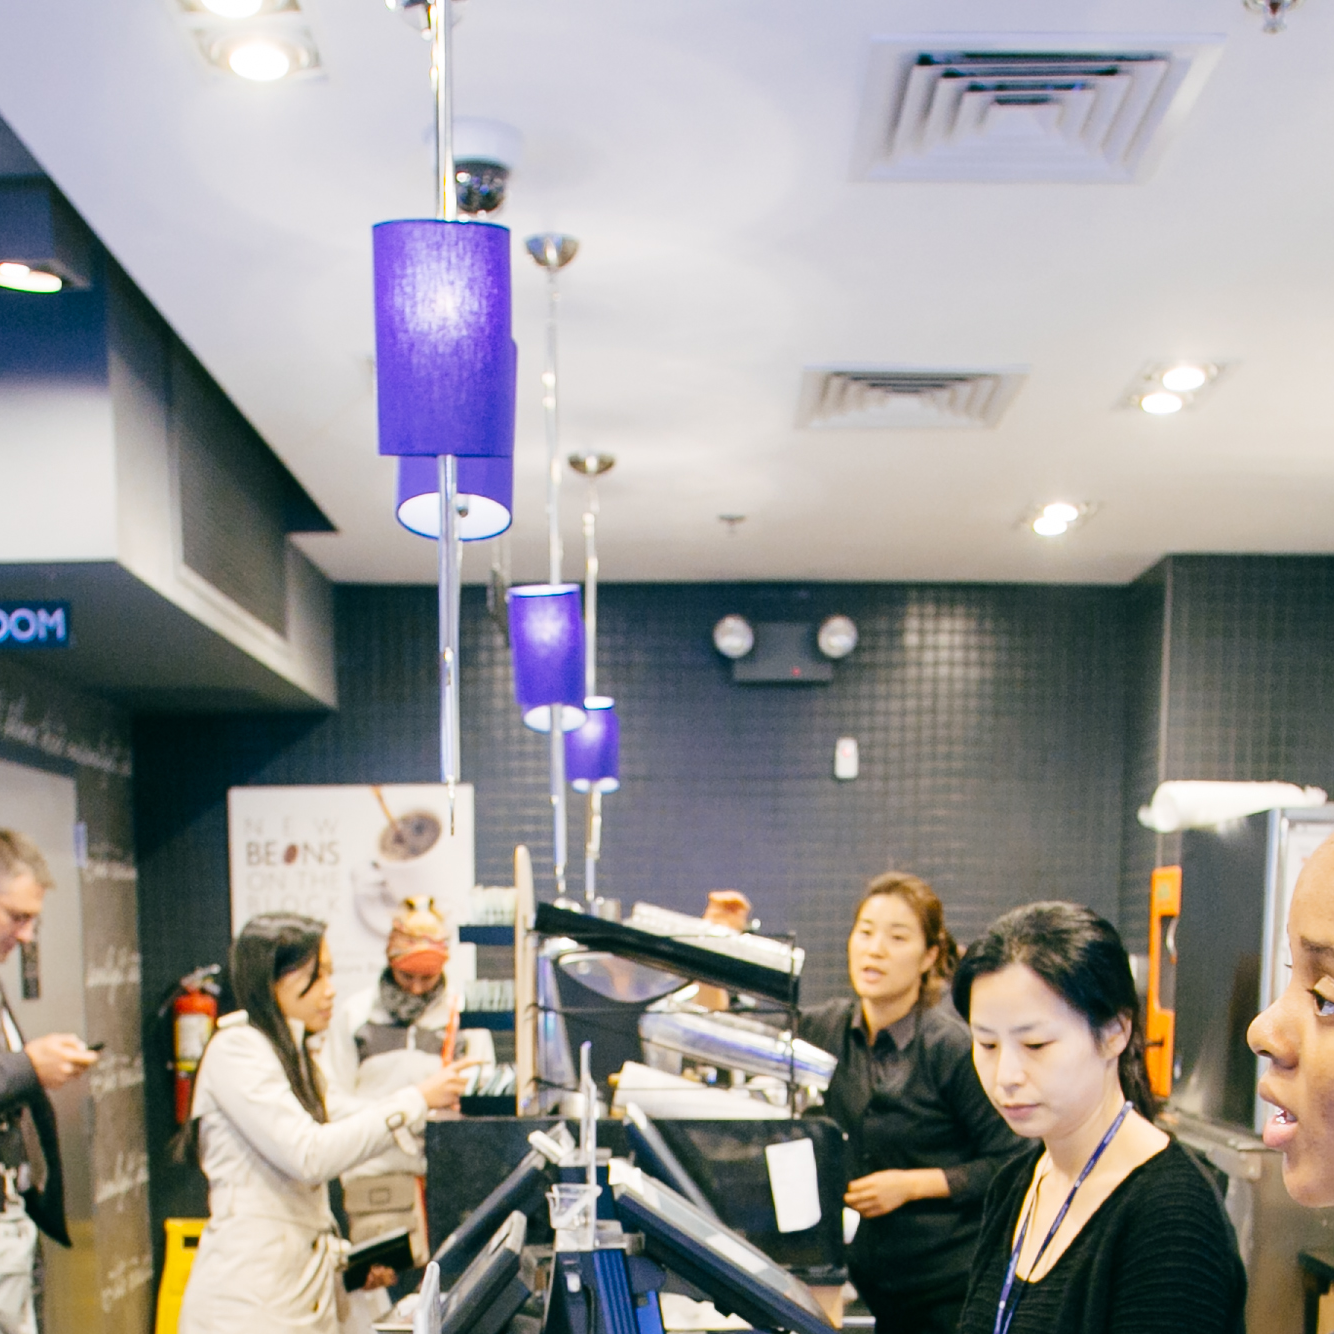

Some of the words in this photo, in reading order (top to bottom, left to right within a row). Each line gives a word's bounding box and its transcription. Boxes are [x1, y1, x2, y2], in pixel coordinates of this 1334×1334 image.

[245, 841, 341, 868] BENS
[247, 870, 287, 893] ON
[298, 870, 341, 893] THE
